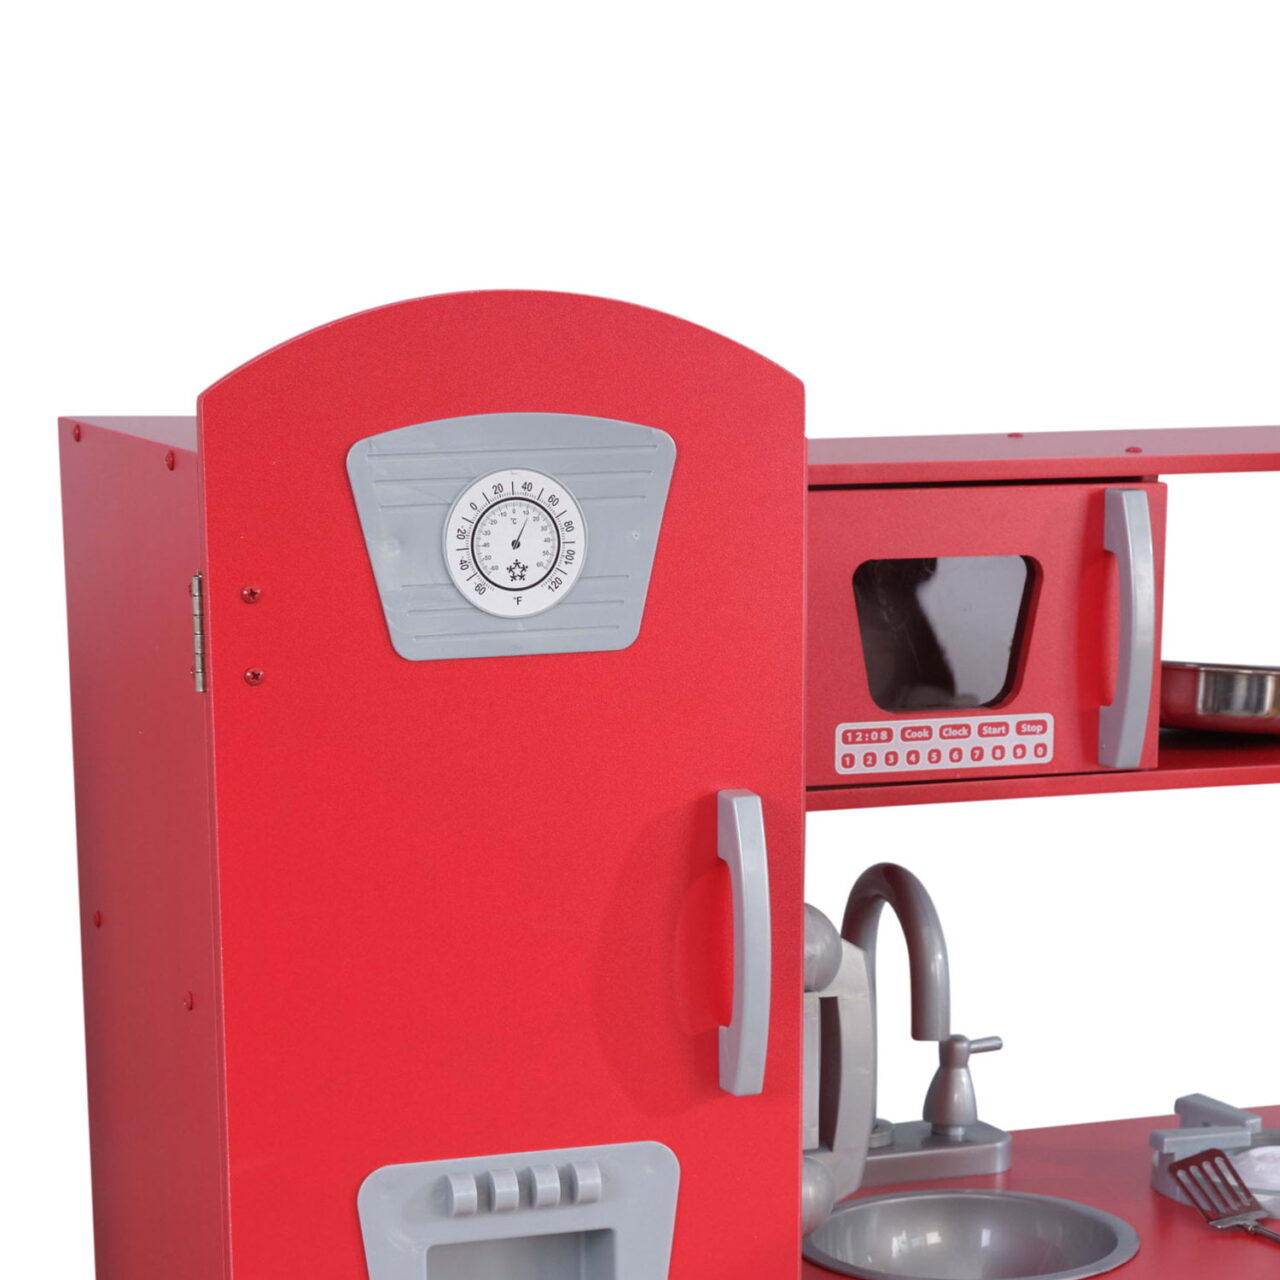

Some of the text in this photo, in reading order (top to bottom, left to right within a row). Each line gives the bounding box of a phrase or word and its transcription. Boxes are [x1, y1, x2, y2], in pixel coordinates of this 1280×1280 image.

[492, 483, 504, 495] 20
[521, 482, 533, 492] 40
[470, 502, 478, 511] 0
[547, 494, 559, 507] 60
[563, 520, 575, 533] 80
[564, 549, 576, 565] 100
[547, 577, 563, 593] 120
[904, 729, 930, 739] Cook
[942, 726, 969, 737] Clock
[982, 725, 1006, 735] Start
[1021, 722, 1043, 734] Stop
[845, 747, 1043, 765] 1 2 3 4 5 6 7 8 9 0
